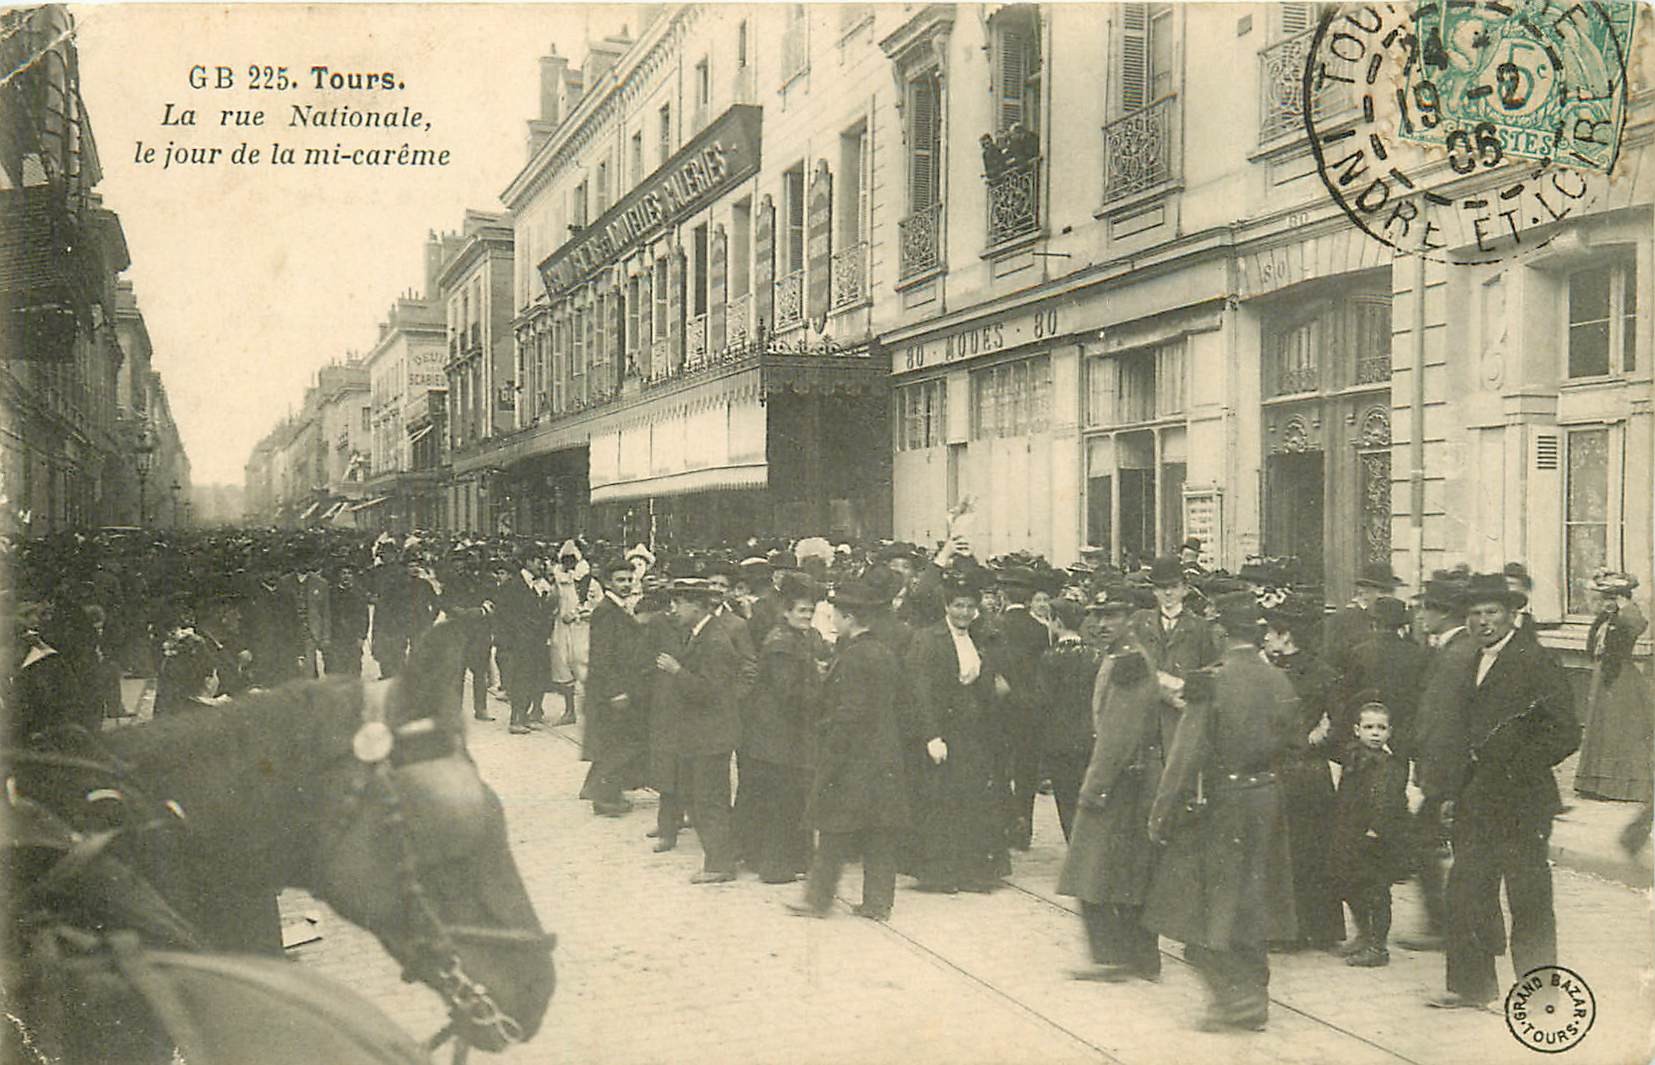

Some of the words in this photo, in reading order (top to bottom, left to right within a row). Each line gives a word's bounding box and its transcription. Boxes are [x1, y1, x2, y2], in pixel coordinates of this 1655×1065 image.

[905, 342, 925, 369] 80
[944, 322, 1004, 361] MODES
[1033, 308, 1058, 338] 80
